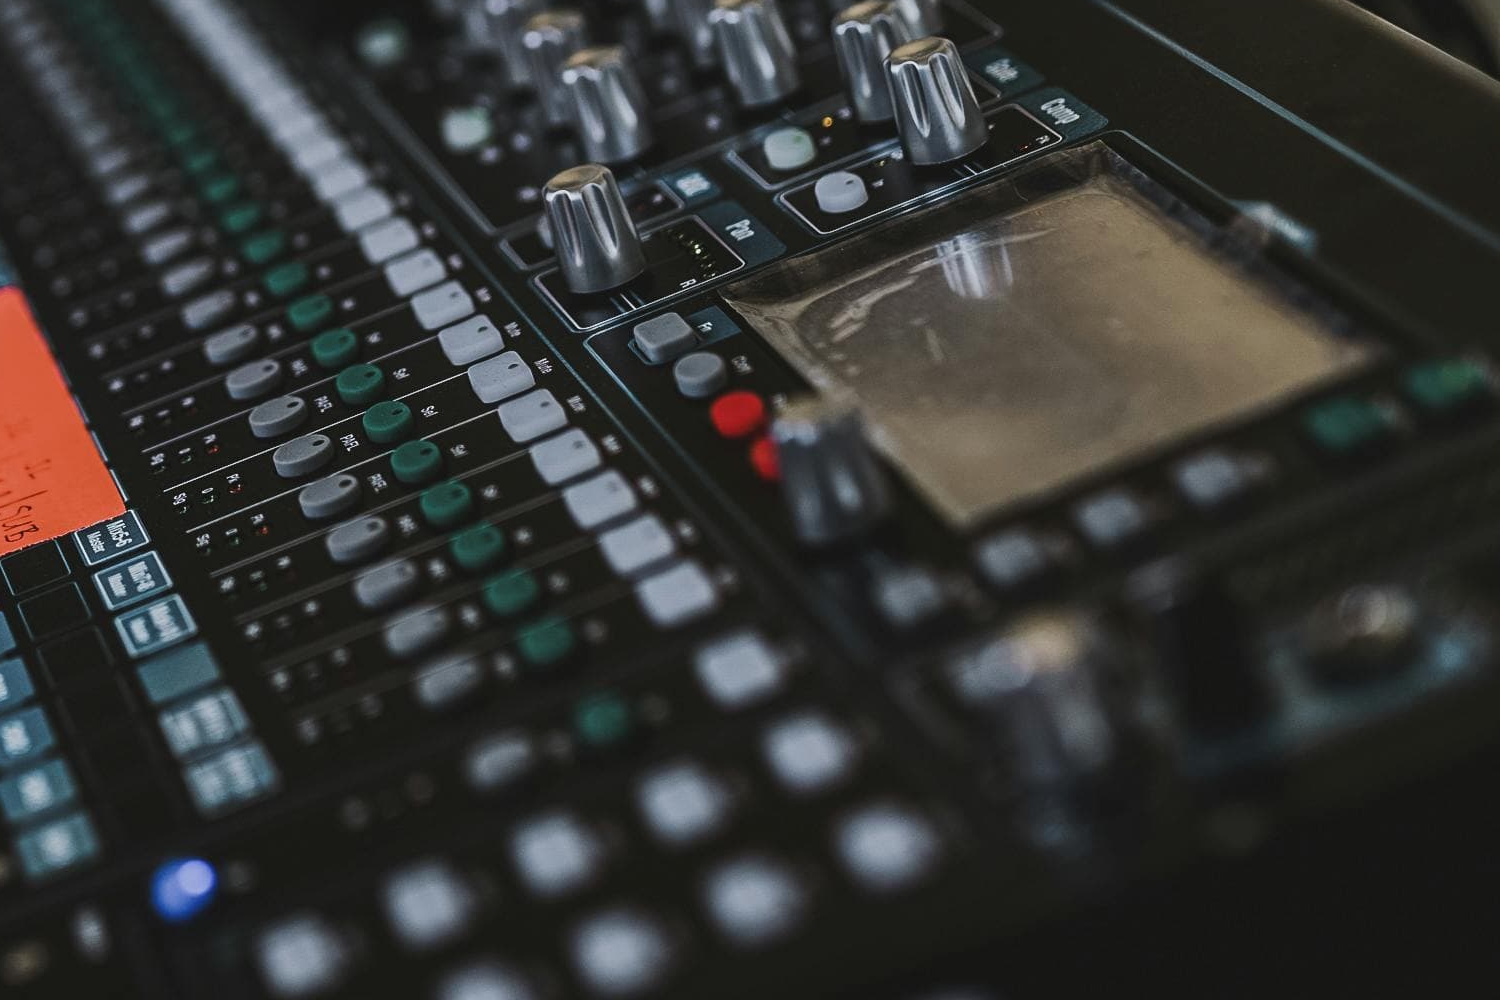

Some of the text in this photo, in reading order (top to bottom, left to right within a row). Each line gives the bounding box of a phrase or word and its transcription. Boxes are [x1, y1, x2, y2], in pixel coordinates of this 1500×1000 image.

[1041, 98, 1080, 125] Comp
[725, 219, 755, 241] Pan
[679, 278, 697, 288] R
[534, 357, 553, 375] Mute
[421, 405, 439, 418] Sel
[339, 433, 360, 452] PAFL
[86, 530, 105, 554] Master
[105, 519, 132, 548] Mix5-6
